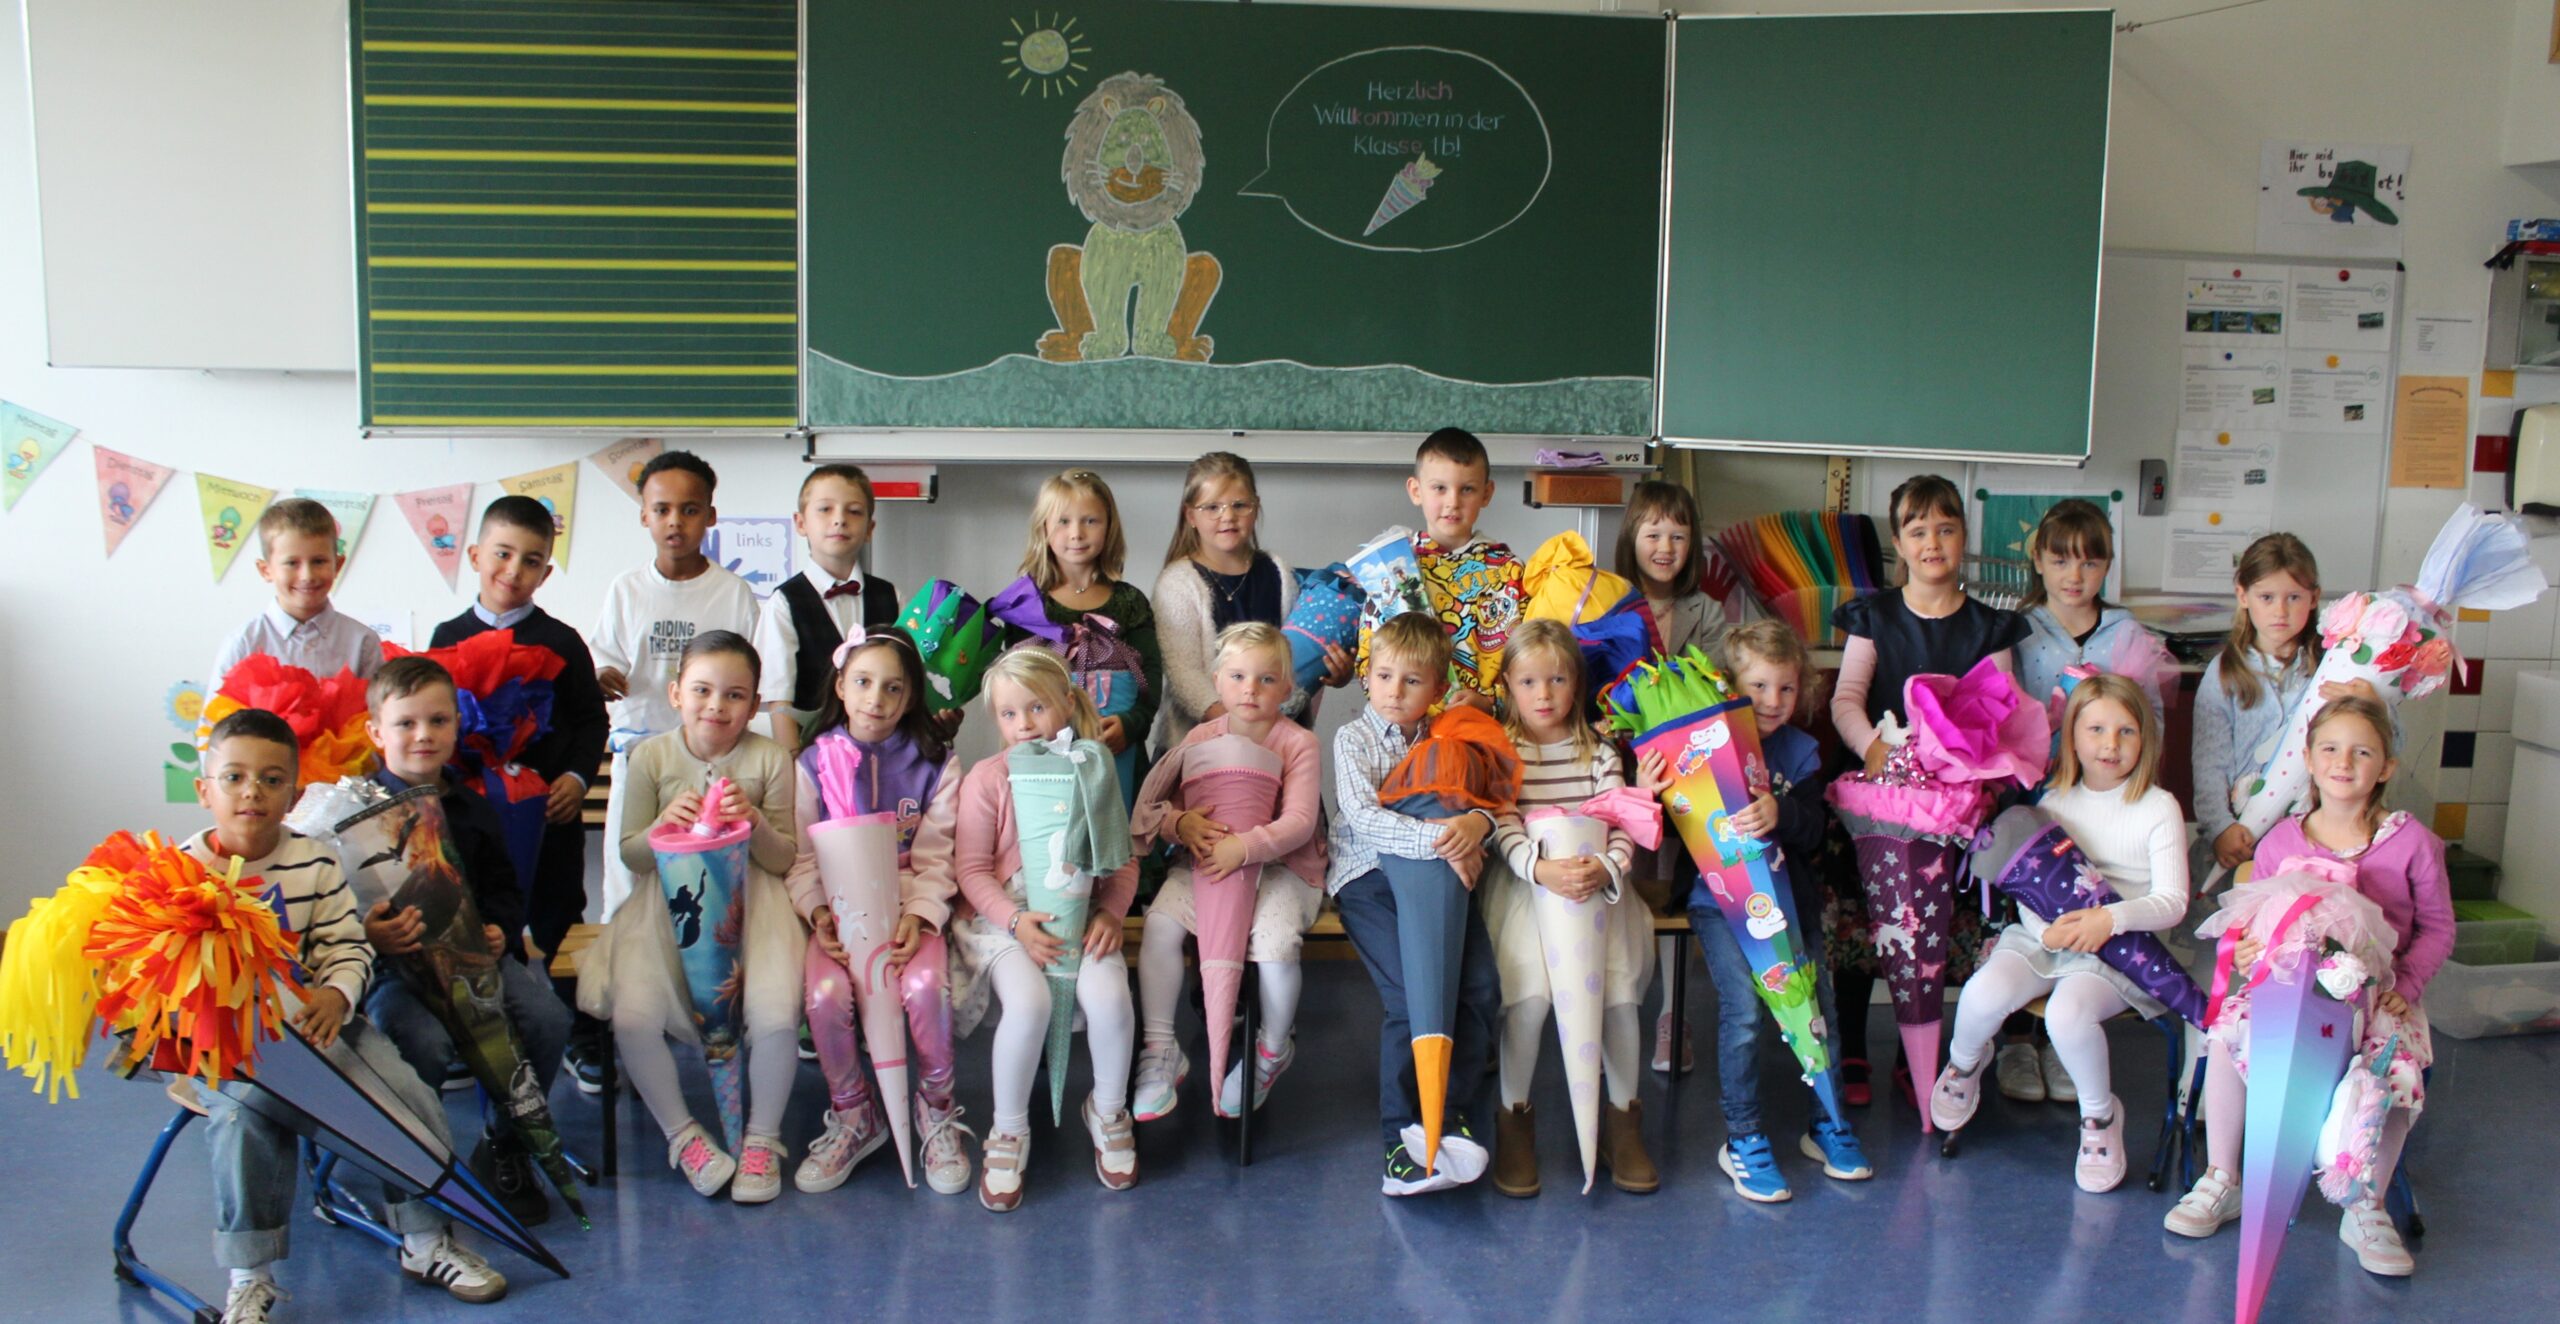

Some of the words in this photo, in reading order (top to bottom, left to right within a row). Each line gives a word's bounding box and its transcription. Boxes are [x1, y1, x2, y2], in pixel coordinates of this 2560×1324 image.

[1368, 80, 1453, 101] Herzlich
[1313, 103, 1440, 128] Willkommen
[1445, 112, 1464, 128] in
[1467, 111, 1506, 131] der
[1354, 135, 1423, 155] Klasse
[2289, 162, 2305, 173] ihr
[736, 532, 773, 548] links
[653, 620, 695, 638] RIDING
[649, 635, 666, 655] THE
